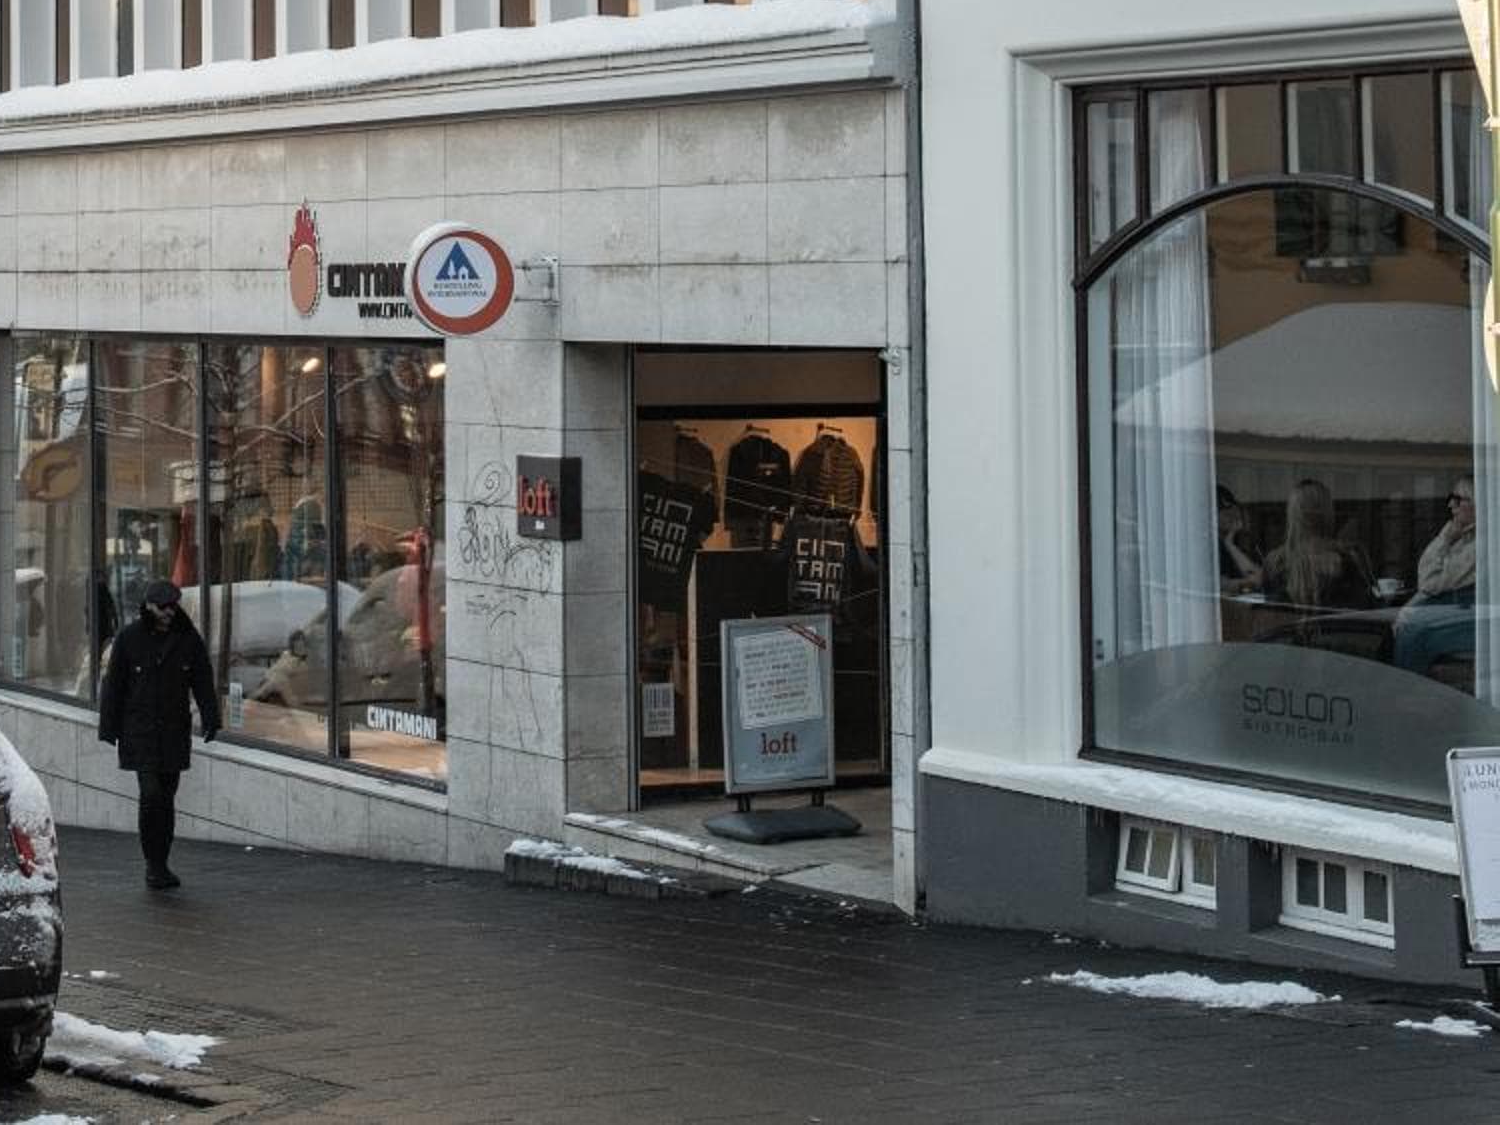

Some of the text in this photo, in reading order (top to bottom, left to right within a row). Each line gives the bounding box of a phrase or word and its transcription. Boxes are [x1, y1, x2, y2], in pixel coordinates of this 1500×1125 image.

[517, 474, 556, 517] loft
[366, 704, 438, 740] CINTAMANI
[761, 731, 798, 755] loft
[1464, 763, 1500, 777] LUN
